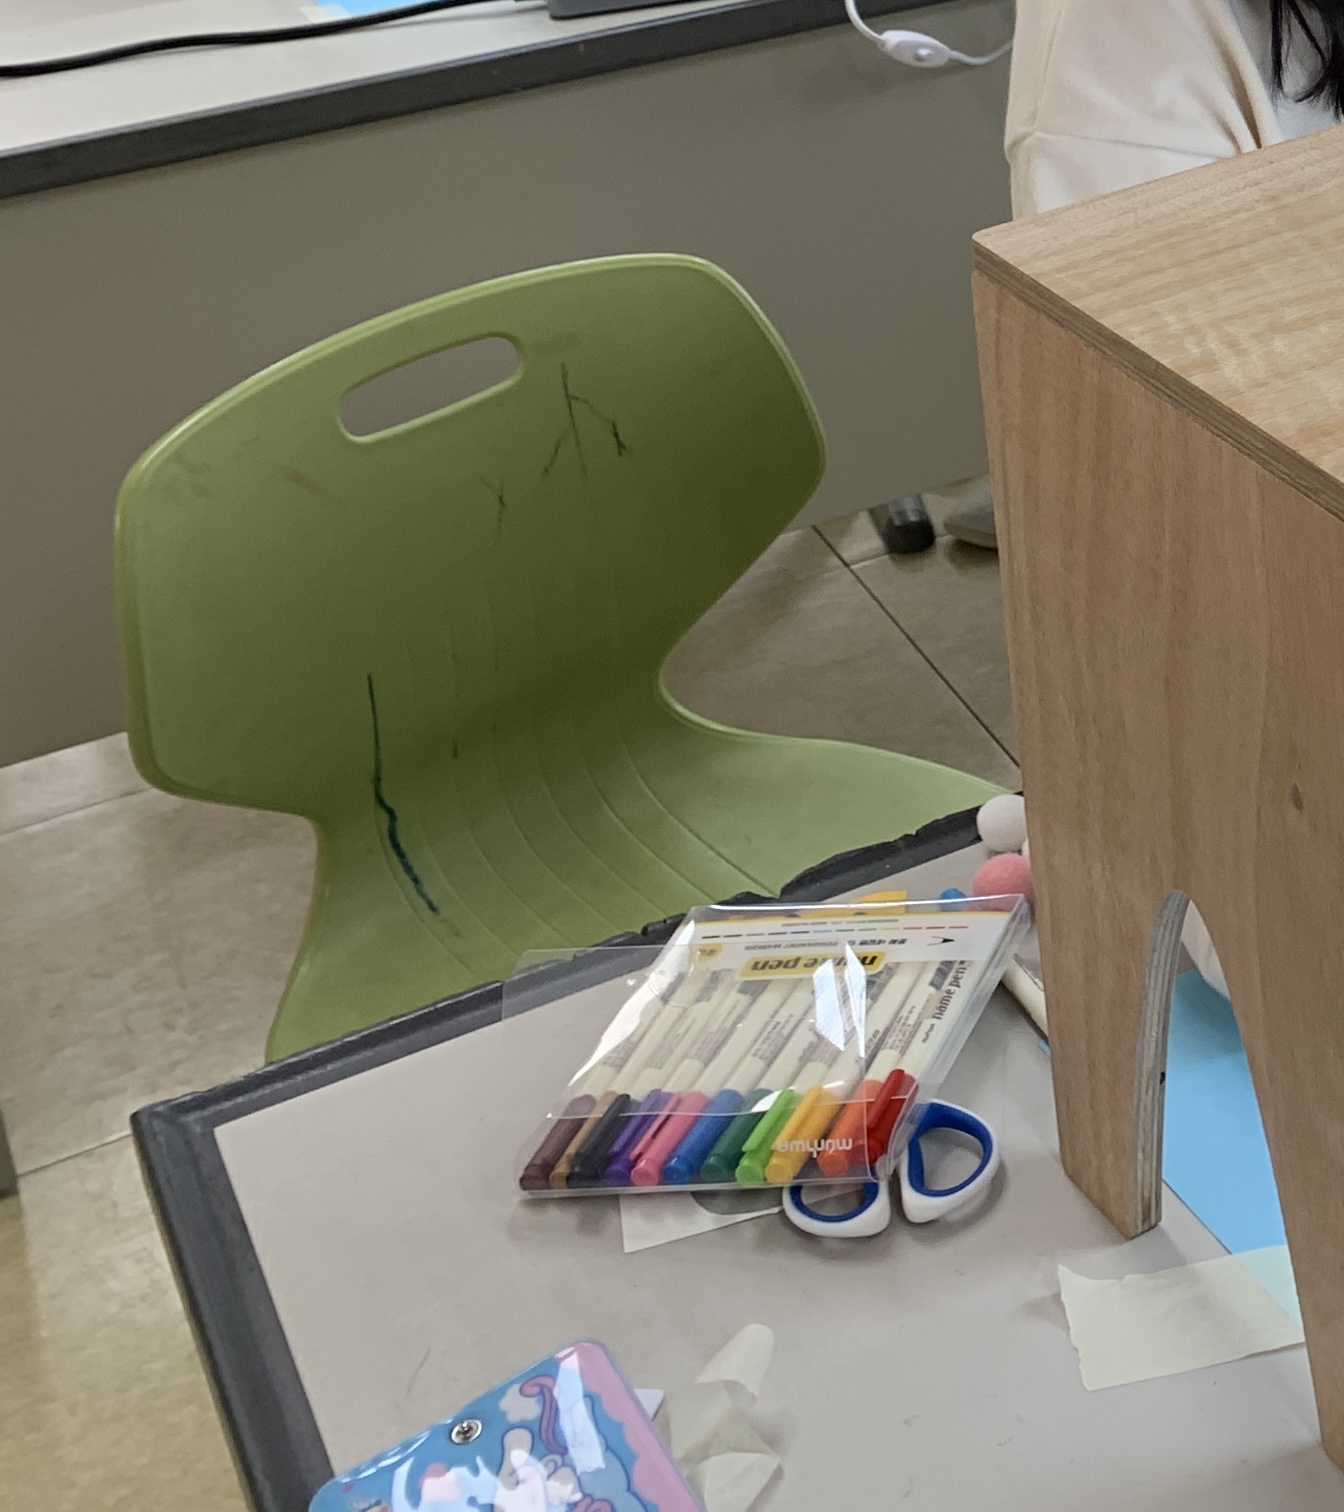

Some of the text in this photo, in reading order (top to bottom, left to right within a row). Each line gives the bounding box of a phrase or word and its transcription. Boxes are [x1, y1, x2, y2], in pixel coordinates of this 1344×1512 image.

[751, 956, 801, 971] pen
[932, 966, 968, 1020] name pen
